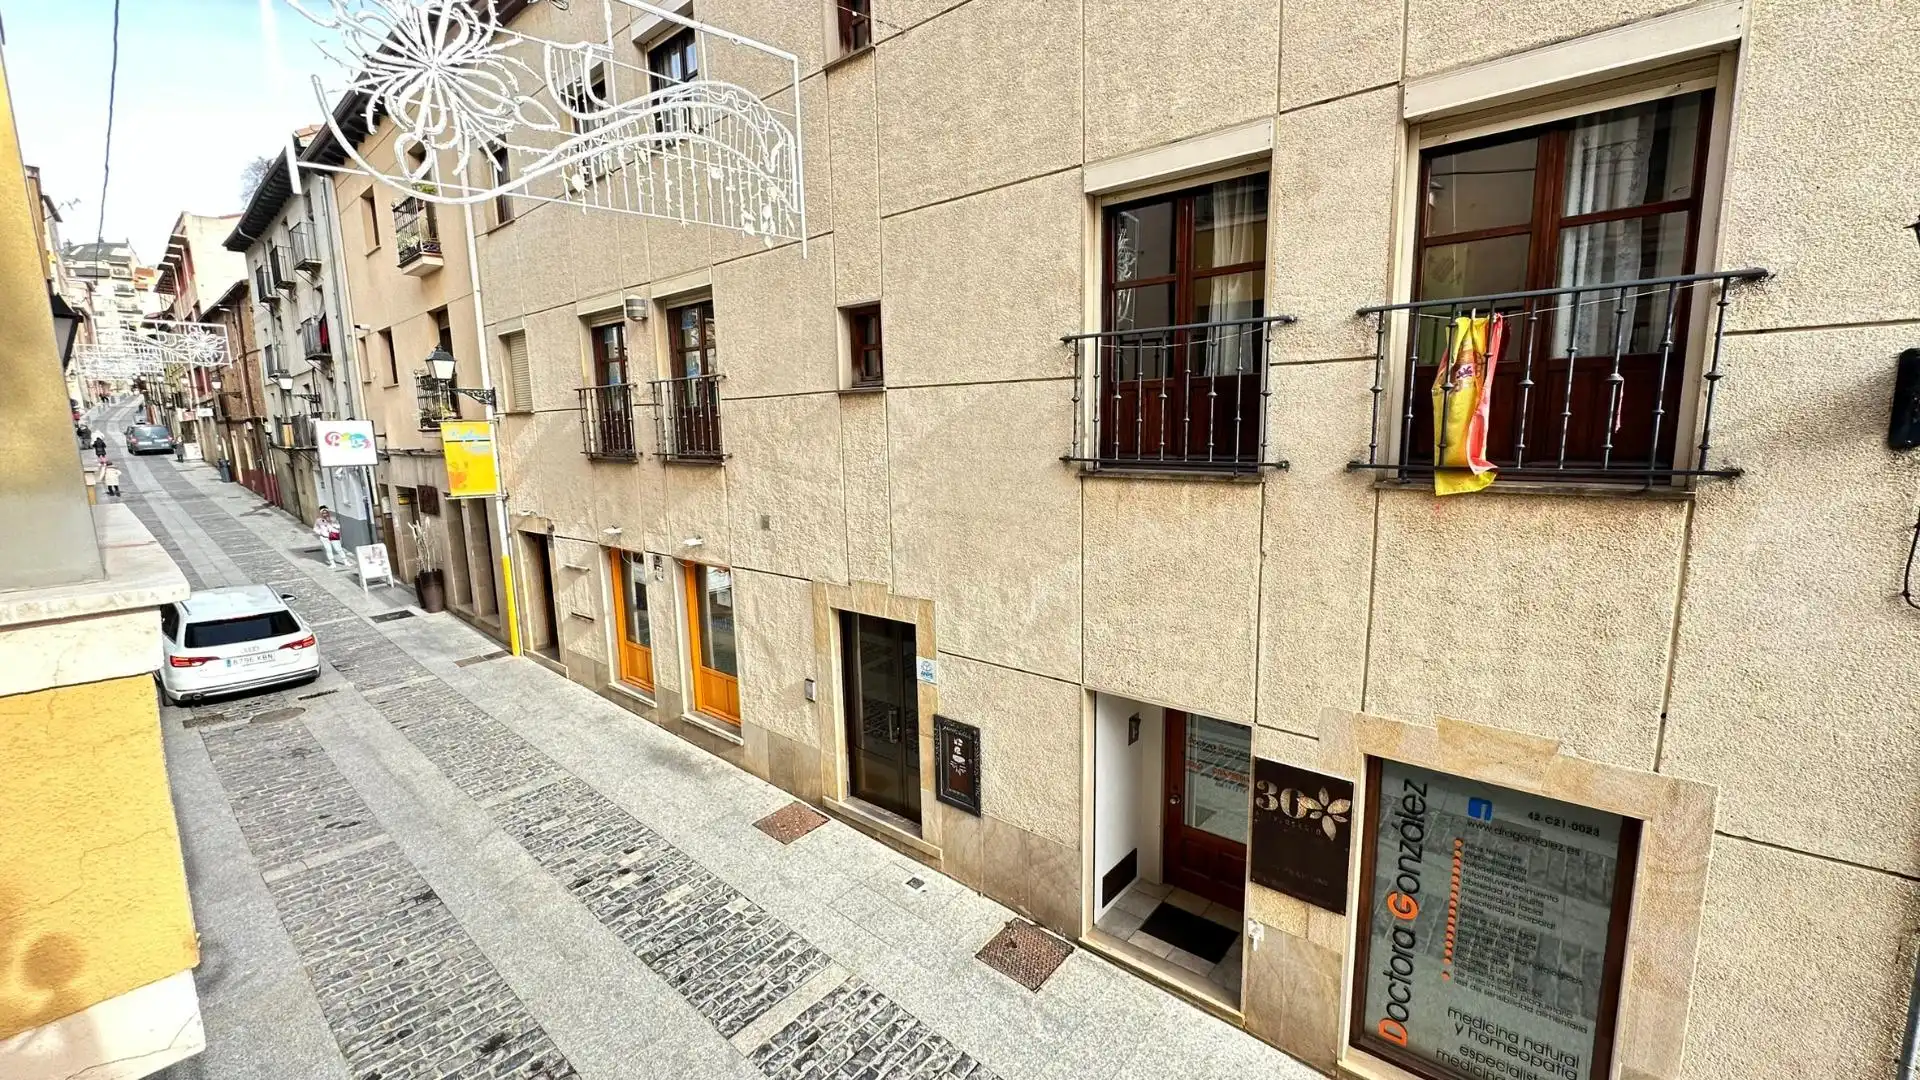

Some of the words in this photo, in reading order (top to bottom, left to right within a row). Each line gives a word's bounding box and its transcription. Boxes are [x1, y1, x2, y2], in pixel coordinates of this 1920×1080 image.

[1256, 780, 1307, 819] 30
[1387, 778, 1428, 920] González
[1378, 925, 1416, 1048] Doctora
[1447, 1006, 1519, 1044] medicina
[1523, 1035, 1580, 1069] natural
[1455, 1022, 1464, 1036] y
[1459, 1044, 1545, 1080] especialist
